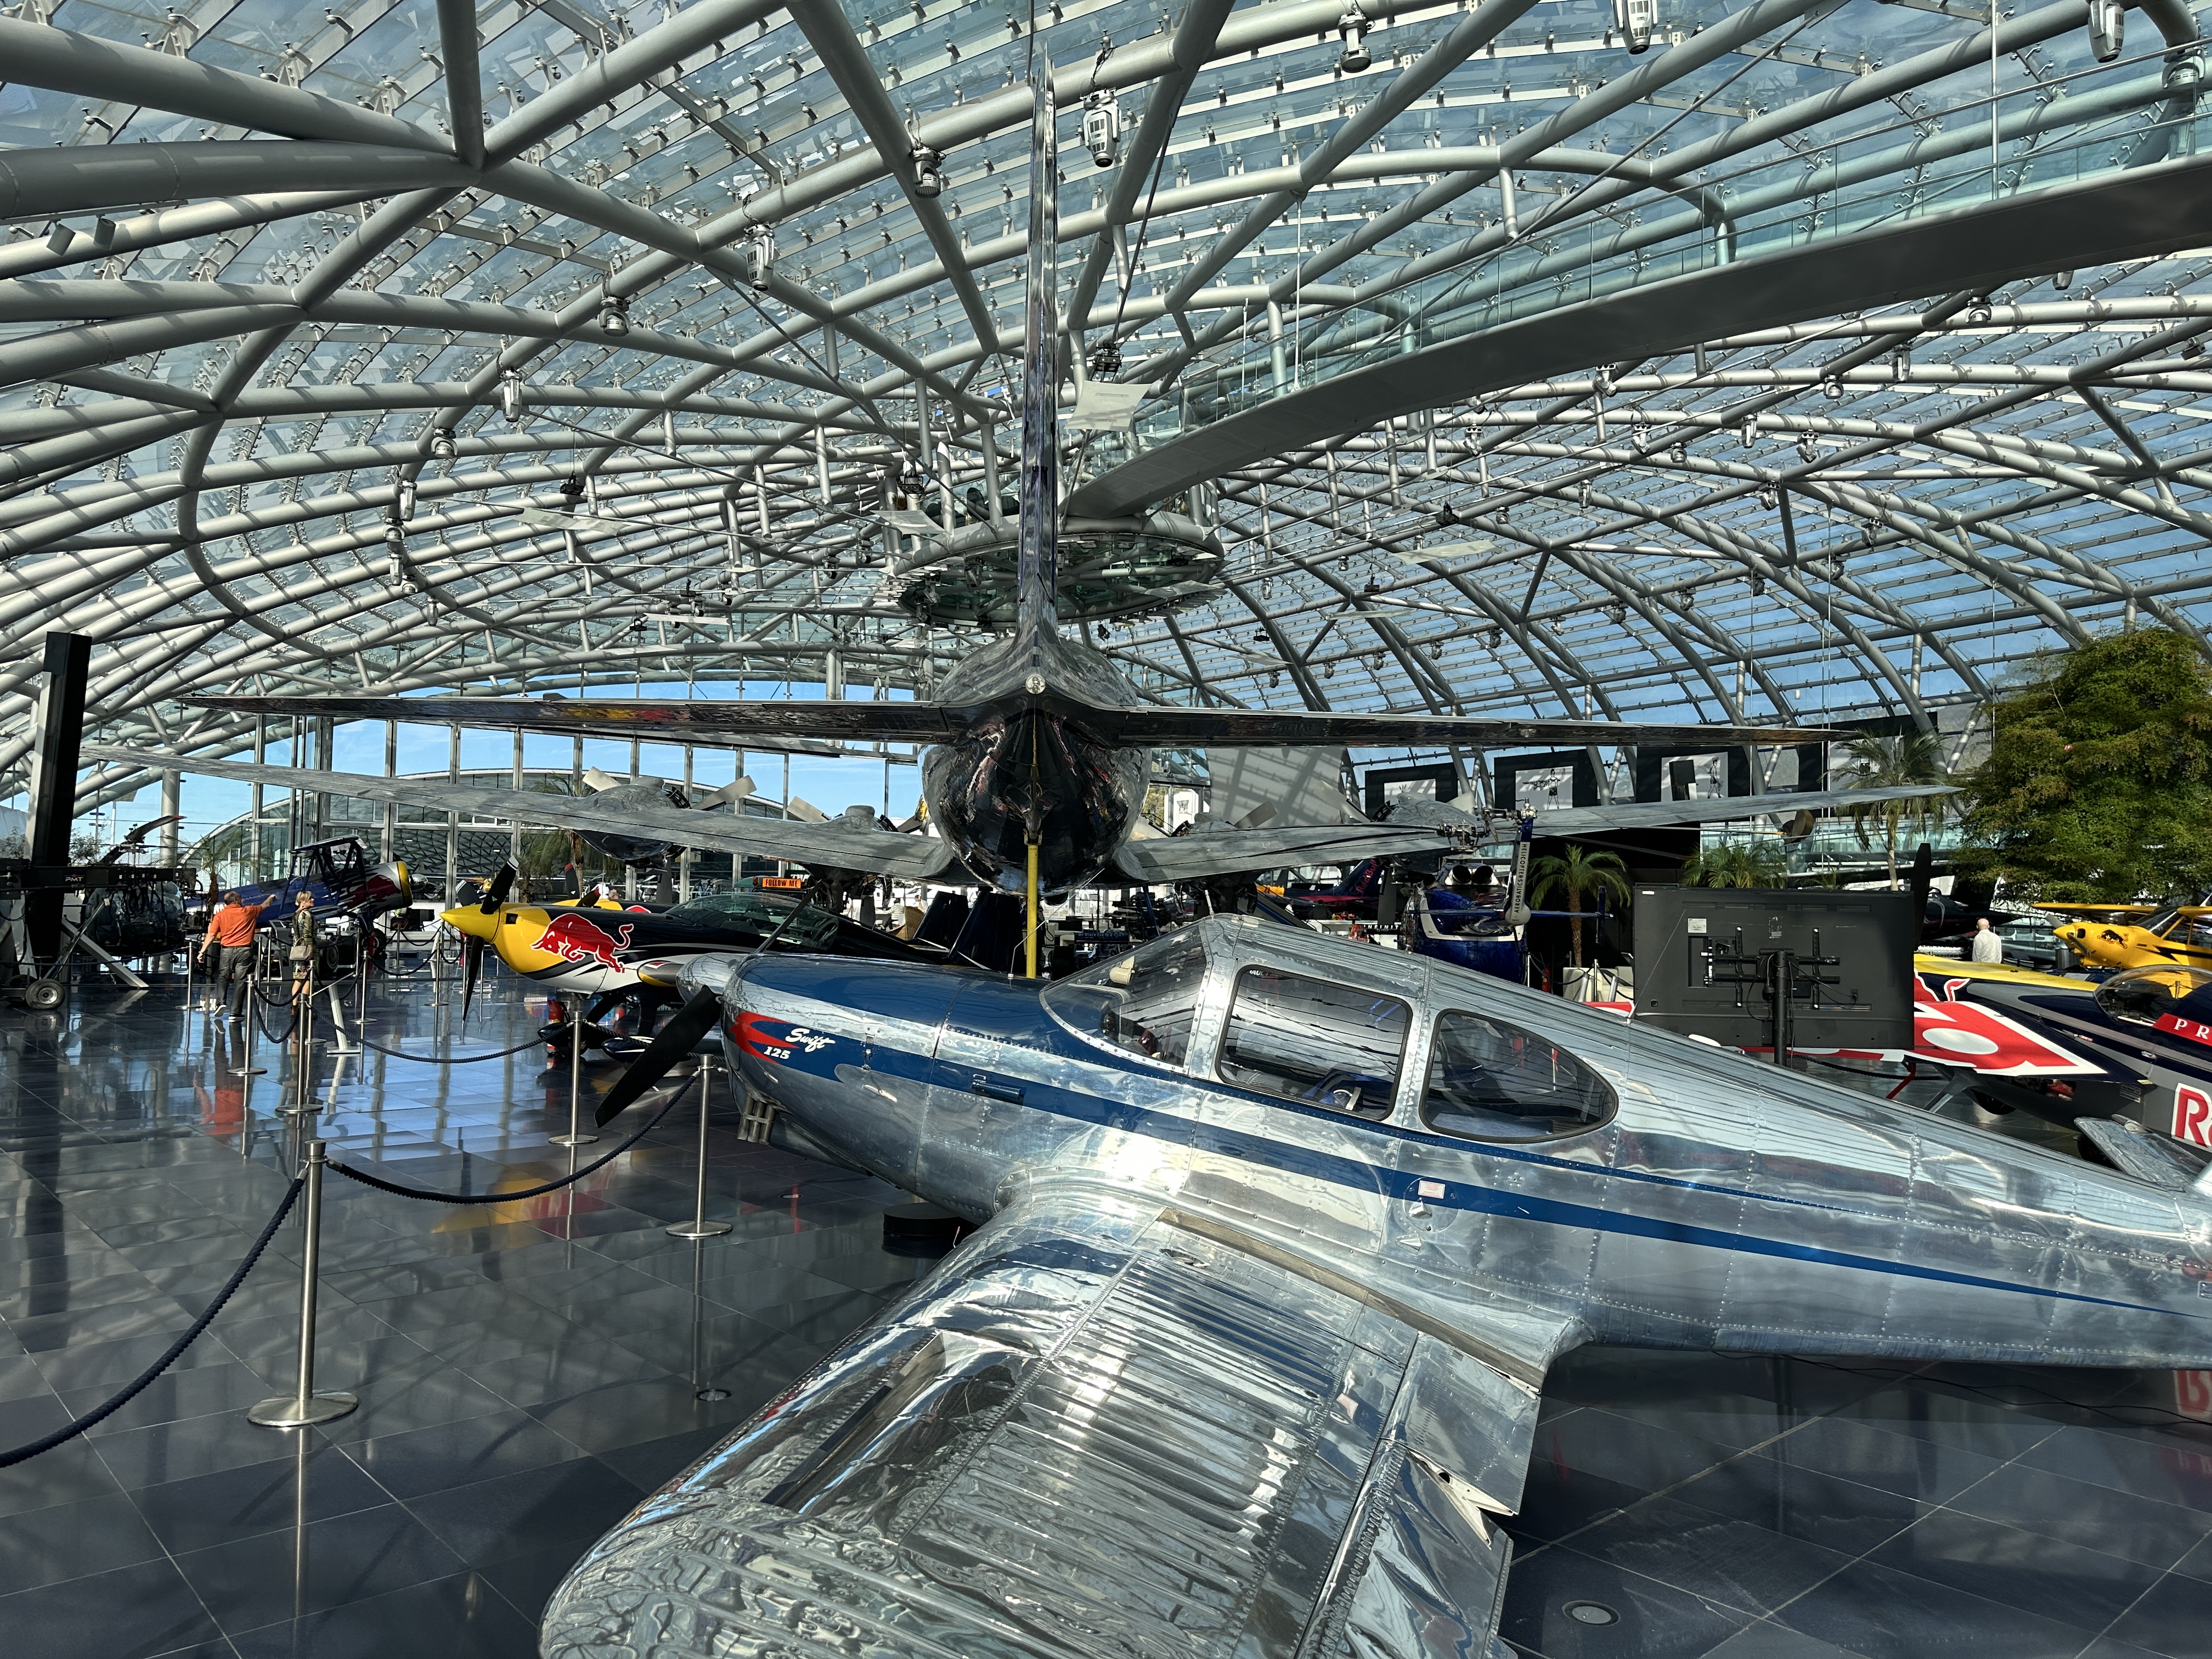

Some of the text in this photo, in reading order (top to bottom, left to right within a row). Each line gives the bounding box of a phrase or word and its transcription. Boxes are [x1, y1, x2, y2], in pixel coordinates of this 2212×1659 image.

[763, 1046, 791, 1059] 125
[785, 1028, 836, 1053] Swift
[2175, 1087, 2212, 1148] R
